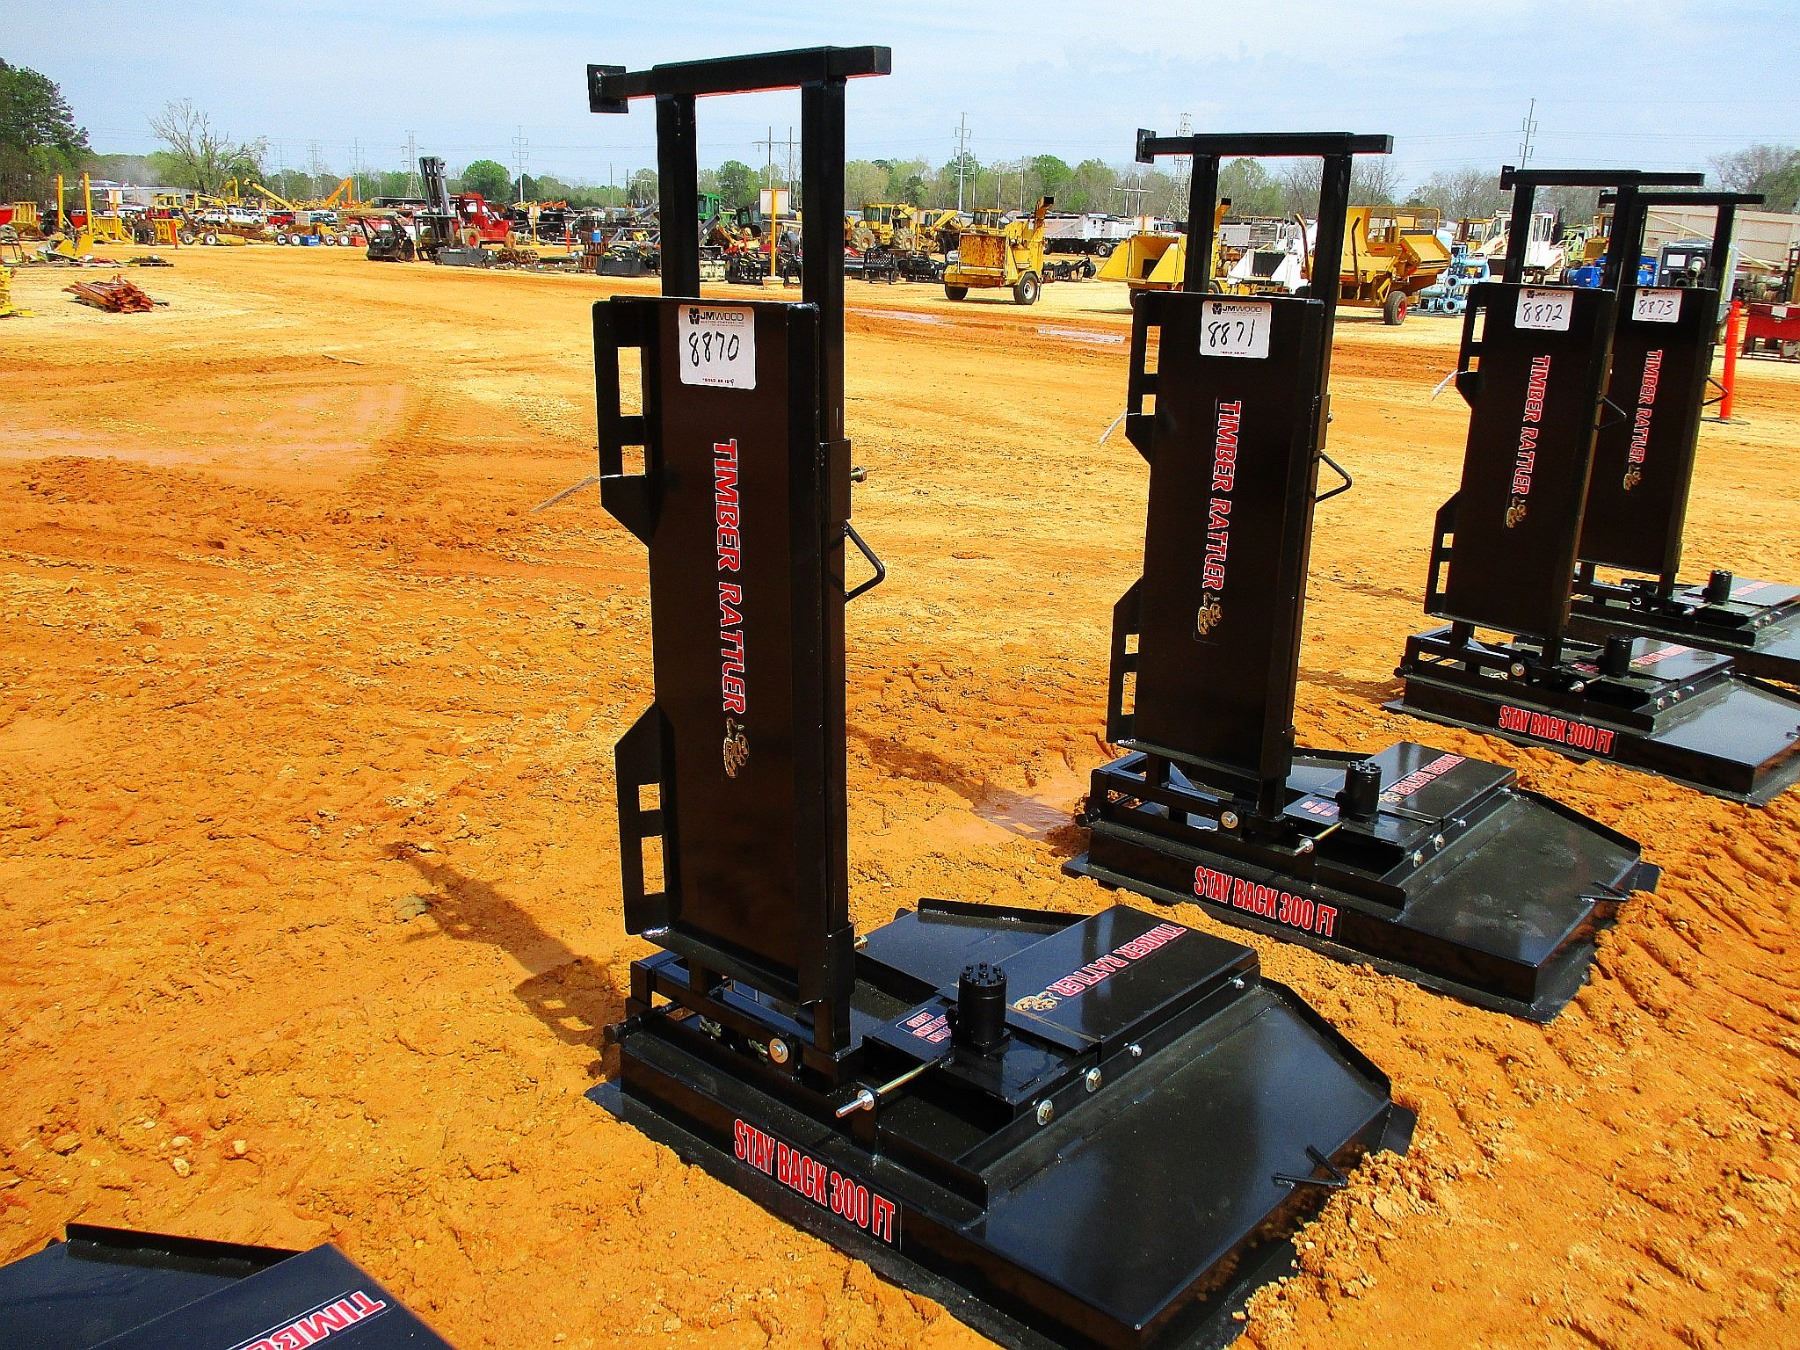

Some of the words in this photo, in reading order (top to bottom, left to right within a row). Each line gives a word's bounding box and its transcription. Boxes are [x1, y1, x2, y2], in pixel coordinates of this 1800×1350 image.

[1208, 318, 1255, 348] 8871
[1522, 301, 1563, 322] 8872
[1639, 299, 1674, 316] 8873
[688, 331, 740, 367] 8870
[1637, 349, 1662, 405] TIMBER
[1522, 354, 1551, 423] TIMBER
[1211, 400, 1241, 492] TIMBER
[1511, 426, 1539, 495] RATTLER
[1628, 407, 1652, 464] RATTLER
[713, 438, 741, 572] TIMBER
[1202, 498, 1232, 591] RATTLER
[718, 581, 746, 714] RATTLER
[1498, 704, 1531, 733] STAY
[1529, 712, 1568, 743] BACK
[1566, 721, 1596, 750] 300
[1594, 728, 1615, 754] FT
[1194, 865, 1233, 904] STAY
[1233, 877, 1278, 920] BACK
[1278, 892, 1314, 931] 300
[1315, 903, 1337, 937] FT
[1112, 923, 1187, 960] TIMBER
[1046, 954, 1130, 997] RATTLER
[734, 1118, 775, 1176] STAY
[777, 1141, 828, 1207] BACK
[830, 1171, 869, 1229] 300
[872, 1193, 896, 1243] FT
